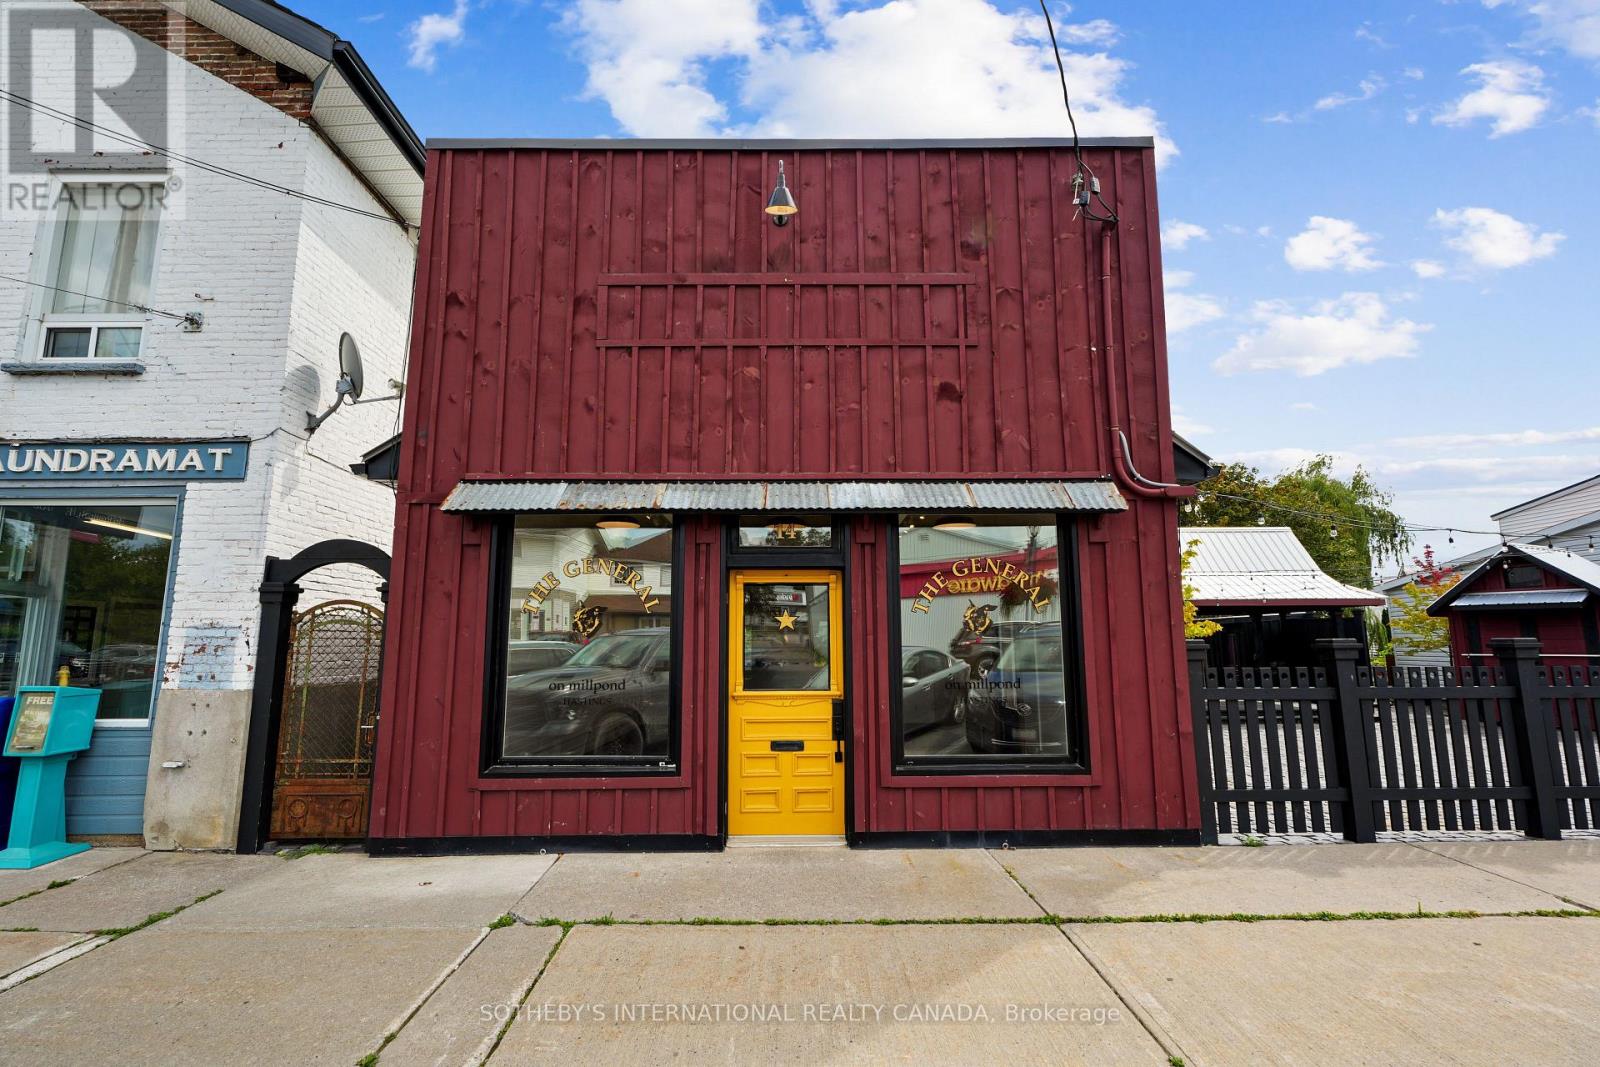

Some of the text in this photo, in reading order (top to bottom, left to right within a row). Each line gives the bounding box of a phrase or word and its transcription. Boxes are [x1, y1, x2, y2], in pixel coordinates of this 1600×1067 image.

[0, 448, 233, 473] UNDRAMAT
[521, 557, 660, 615] THE GENERAL
[911, 556, 1051, 615] THE GENERAL
[548, 679, 626, 694] on millpond
[965, 677, 1021, 693] millpond
[26, 696, 55, 705] FREE
